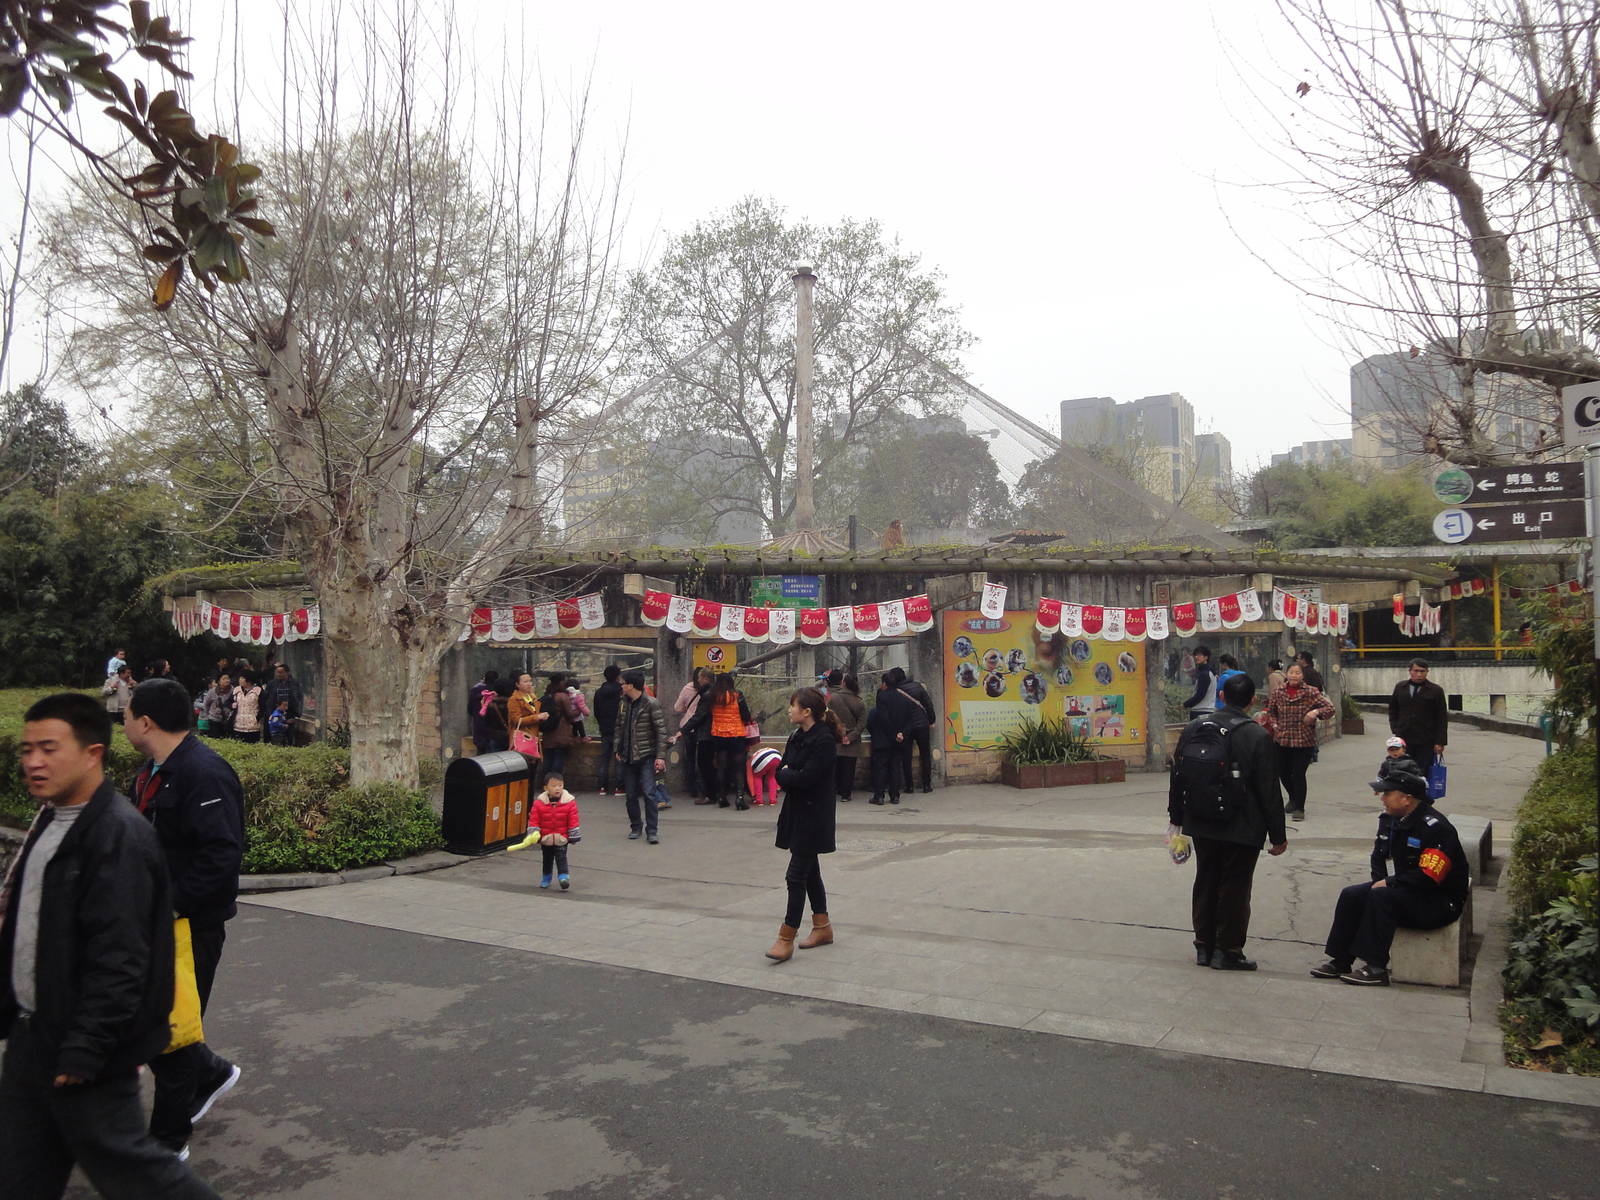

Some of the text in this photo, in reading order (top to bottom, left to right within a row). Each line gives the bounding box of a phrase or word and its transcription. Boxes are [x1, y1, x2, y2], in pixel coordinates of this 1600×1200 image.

[1506, 471, 1560, 485] 鳄鱼 蛇
[1512, 511, 1553, 525] 出口
